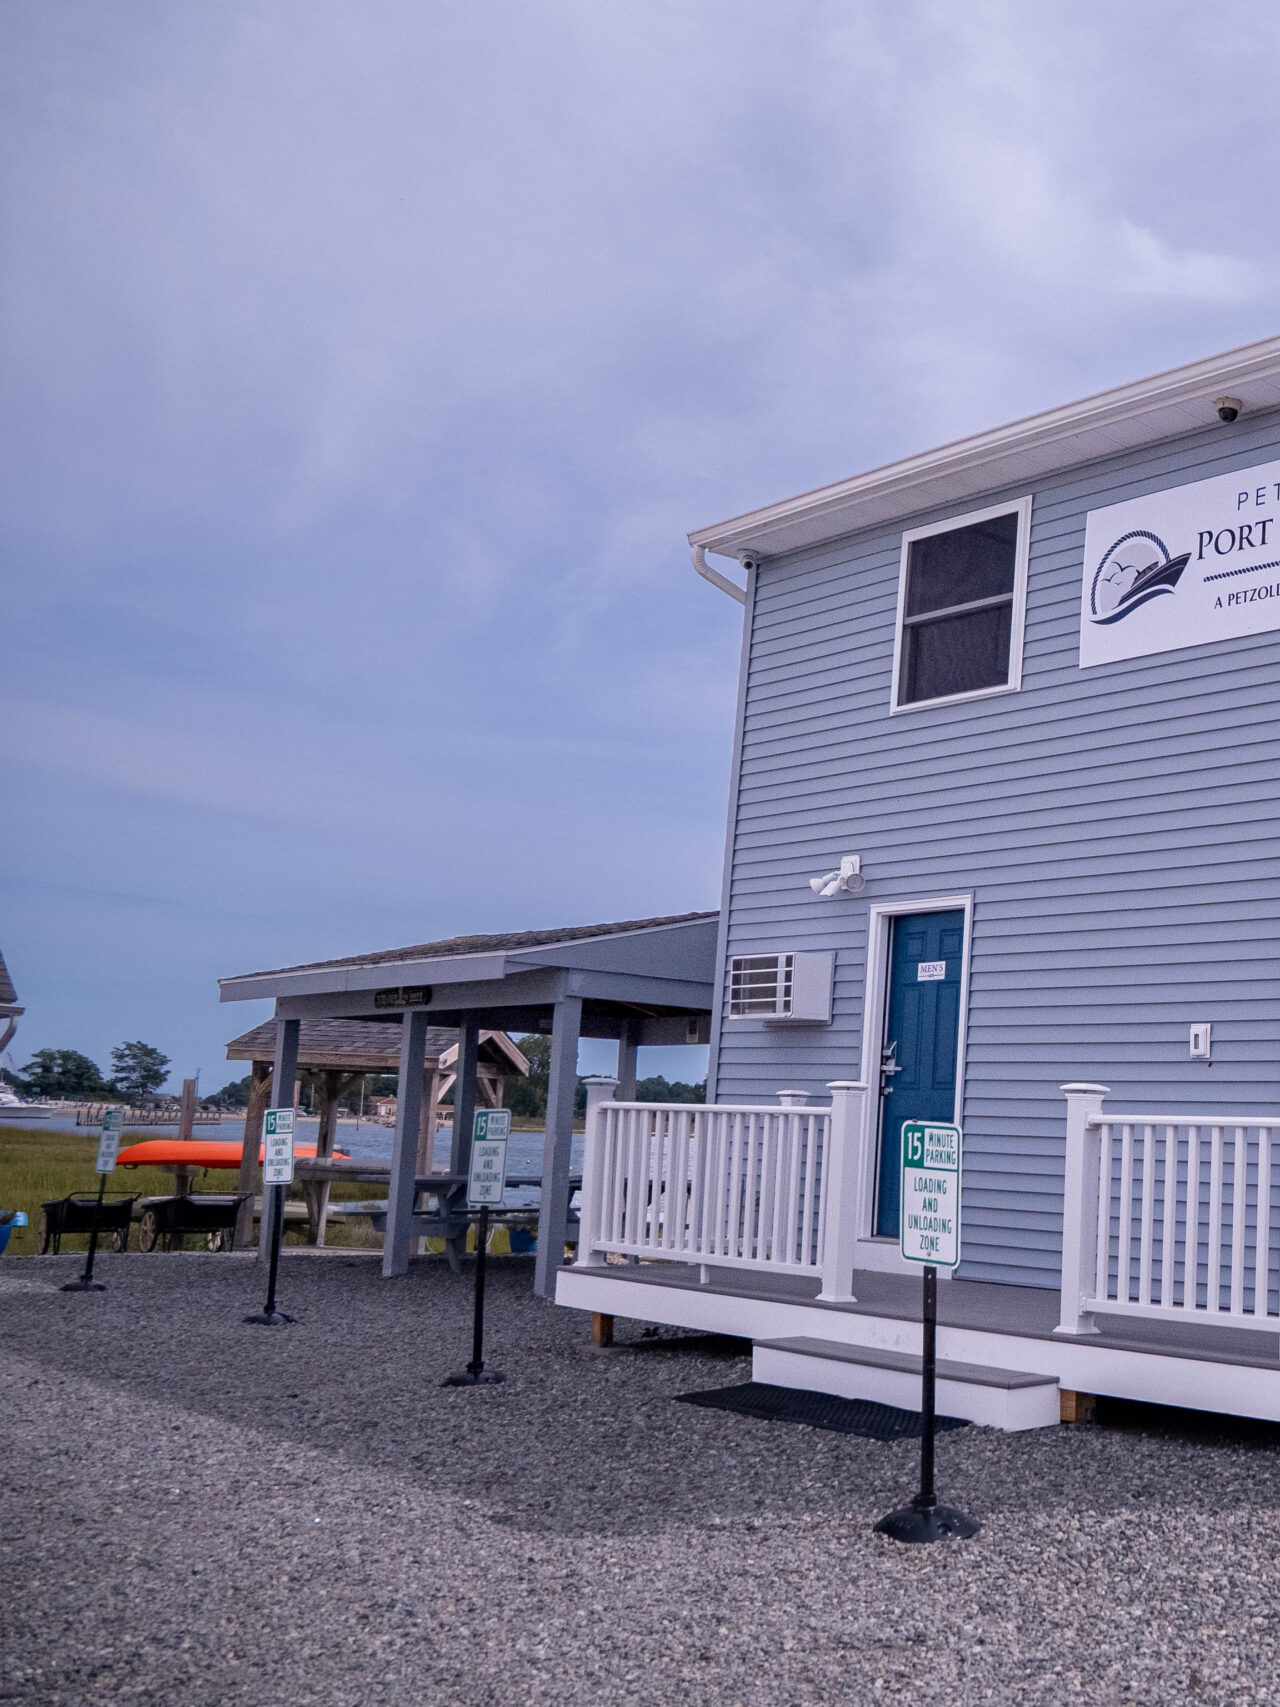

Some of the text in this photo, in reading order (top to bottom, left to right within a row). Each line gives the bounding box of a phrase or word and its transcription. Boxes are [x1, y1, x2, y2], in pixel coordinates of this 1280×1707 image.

[1196, 518, 1274, 561] PORT
[1213, 596, 1223, 609] A
[920, 963, 944, 973] MEN'S
[267, 1115, 276, 1130] 15
[477, 1116, 486, 1136] 15
[908, 1132, 922, 1160] 15
[928, 1132, 954, 1149] MINUTE
[479, 1146, 500, 1156] LOADING
[926, 1148, 956, 1165] PARKING
[914, 1176, 947, 1195] LOADING
[922, 1197, 938, 1213] AND
[908, 1214, 952, 1234] UNLOADING
[920, 1234, 940, 1252] ZONE
